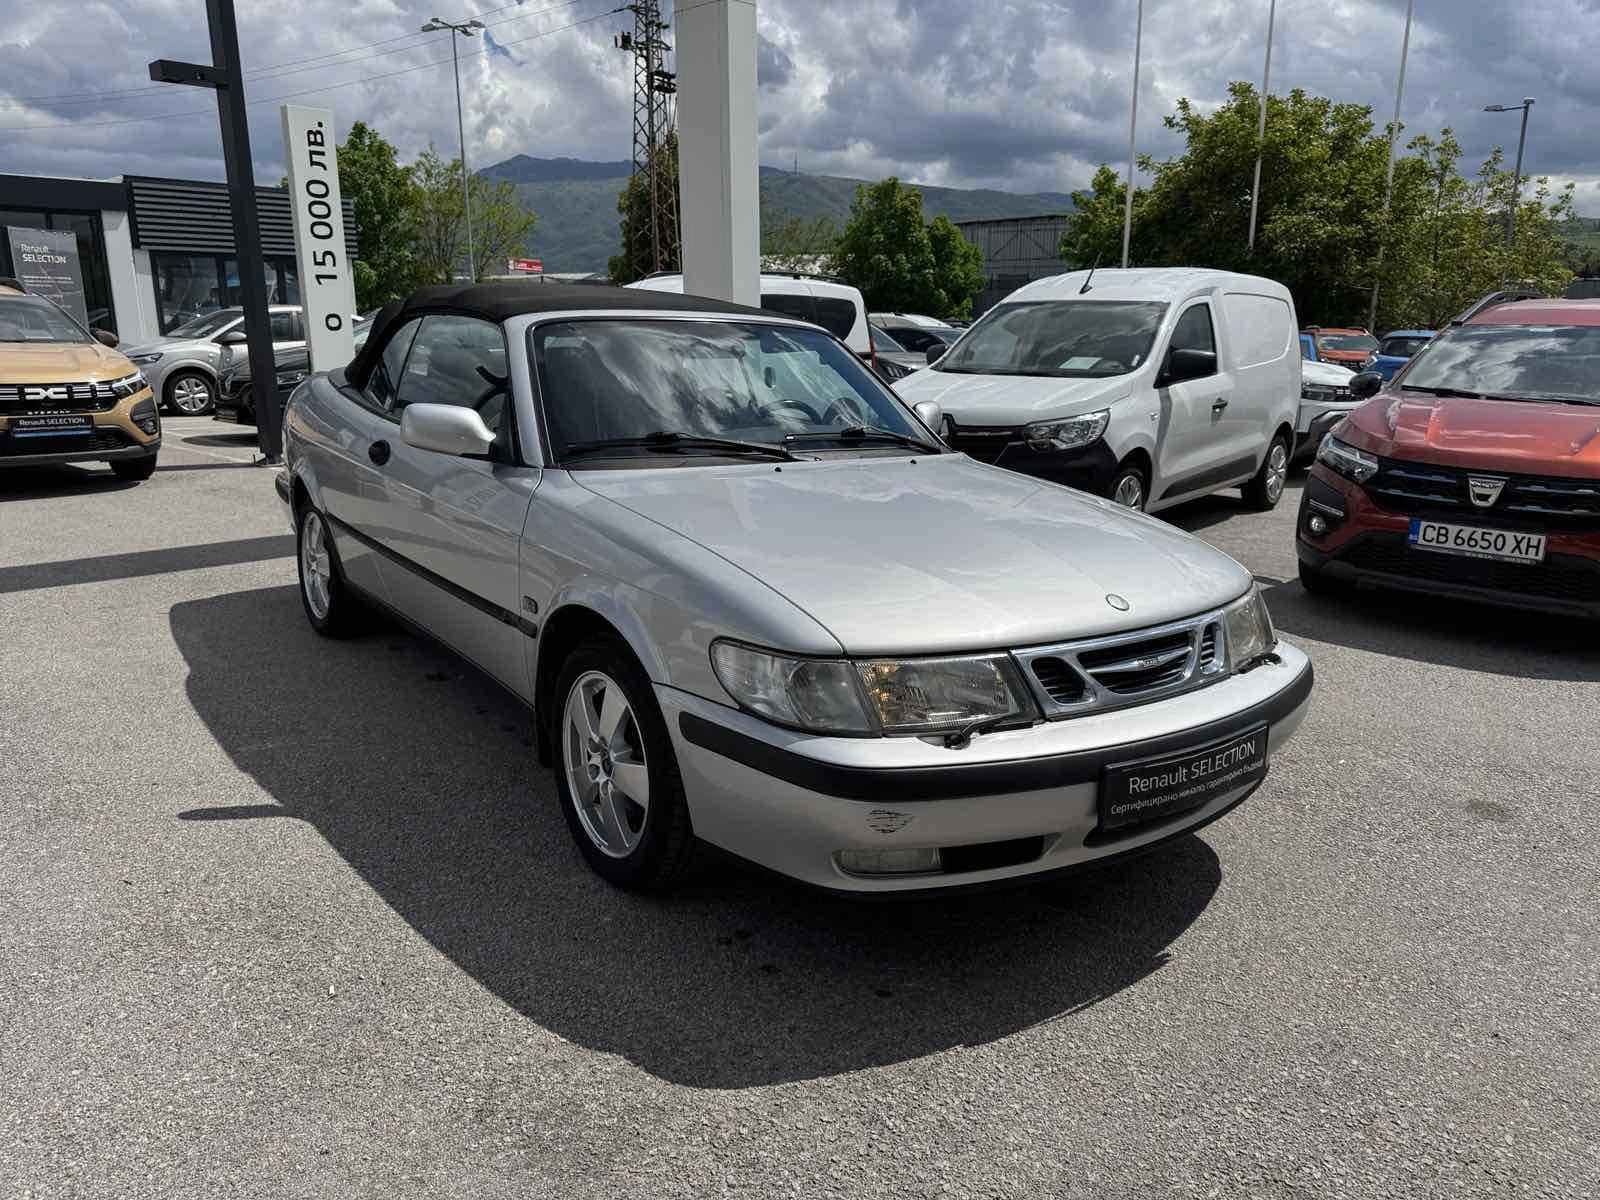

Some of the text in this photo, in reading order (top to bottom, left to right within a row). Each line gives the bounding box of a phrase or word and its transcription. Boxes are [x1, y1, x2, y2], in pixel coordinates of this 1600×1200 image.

[307, 121, 328, 171] лв.
[306, 179, 333, 240] 000
[22, 253, 67, 264] SELECTION
[312, 250, 337, 285] 15
[46, 416, 85, 425] SELECTION
[1422, 525, 1542, 556] CB 6650 XH
[1129, 766, 1188, 793] Renault
[1191, 741, 1255, 778] SELECTION
